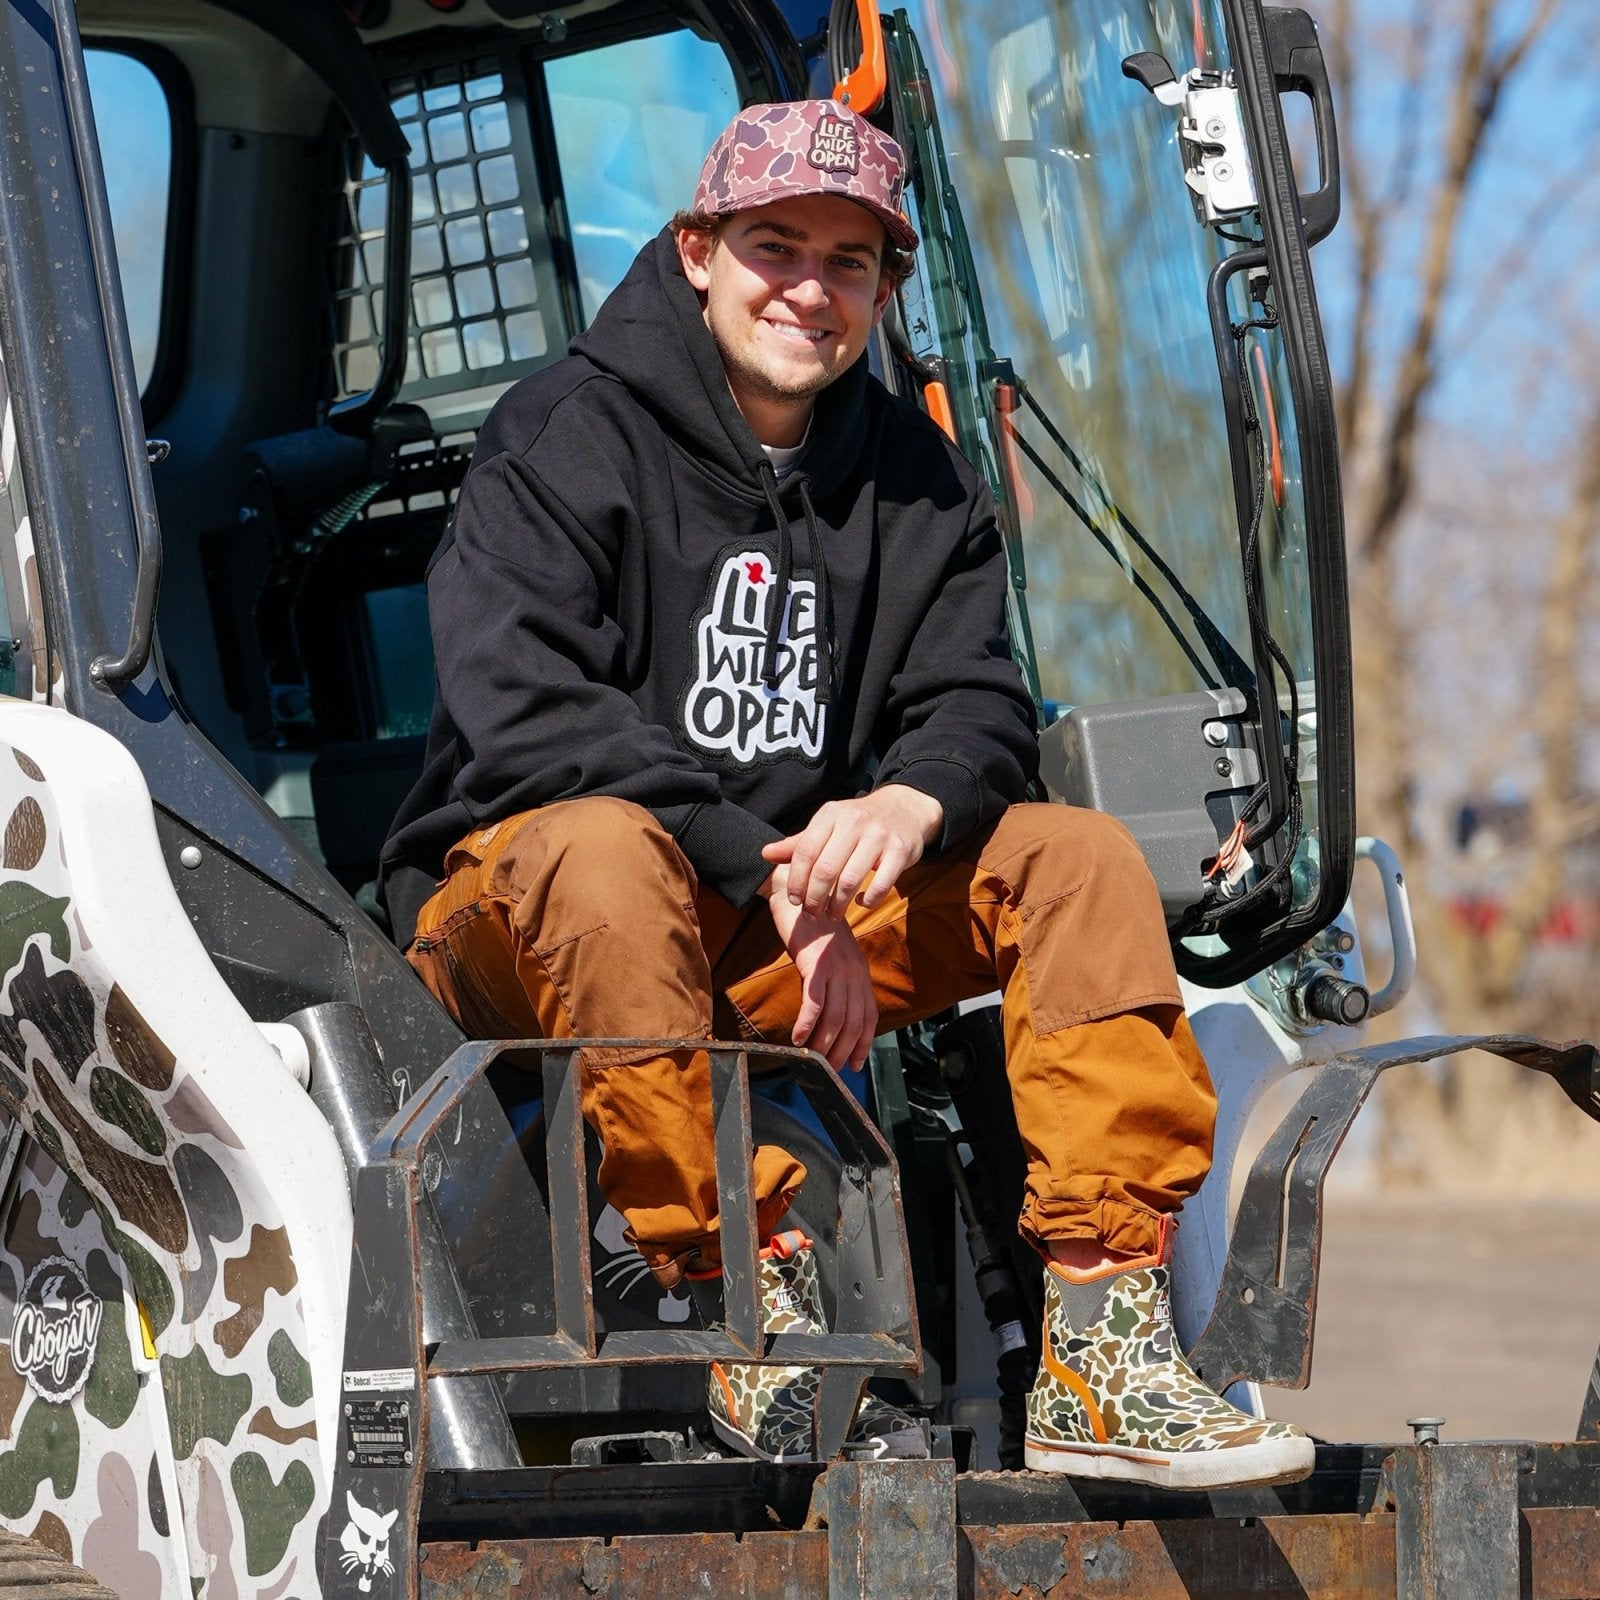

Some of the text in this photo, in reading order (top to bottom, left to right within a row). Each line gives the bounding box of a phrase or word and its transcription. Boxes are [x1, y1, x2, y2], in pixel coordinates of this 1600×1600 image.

[819, 117, 854, 140] LIFE
[815, 133, 857, 153] WIDE
[811, 149, 856, 169] OPEN
[692, 687, 821, 751] OPEN
[14, 1299, 100, 1379] CboysTV
[353, 1376, 372, 1387] Bobcat
